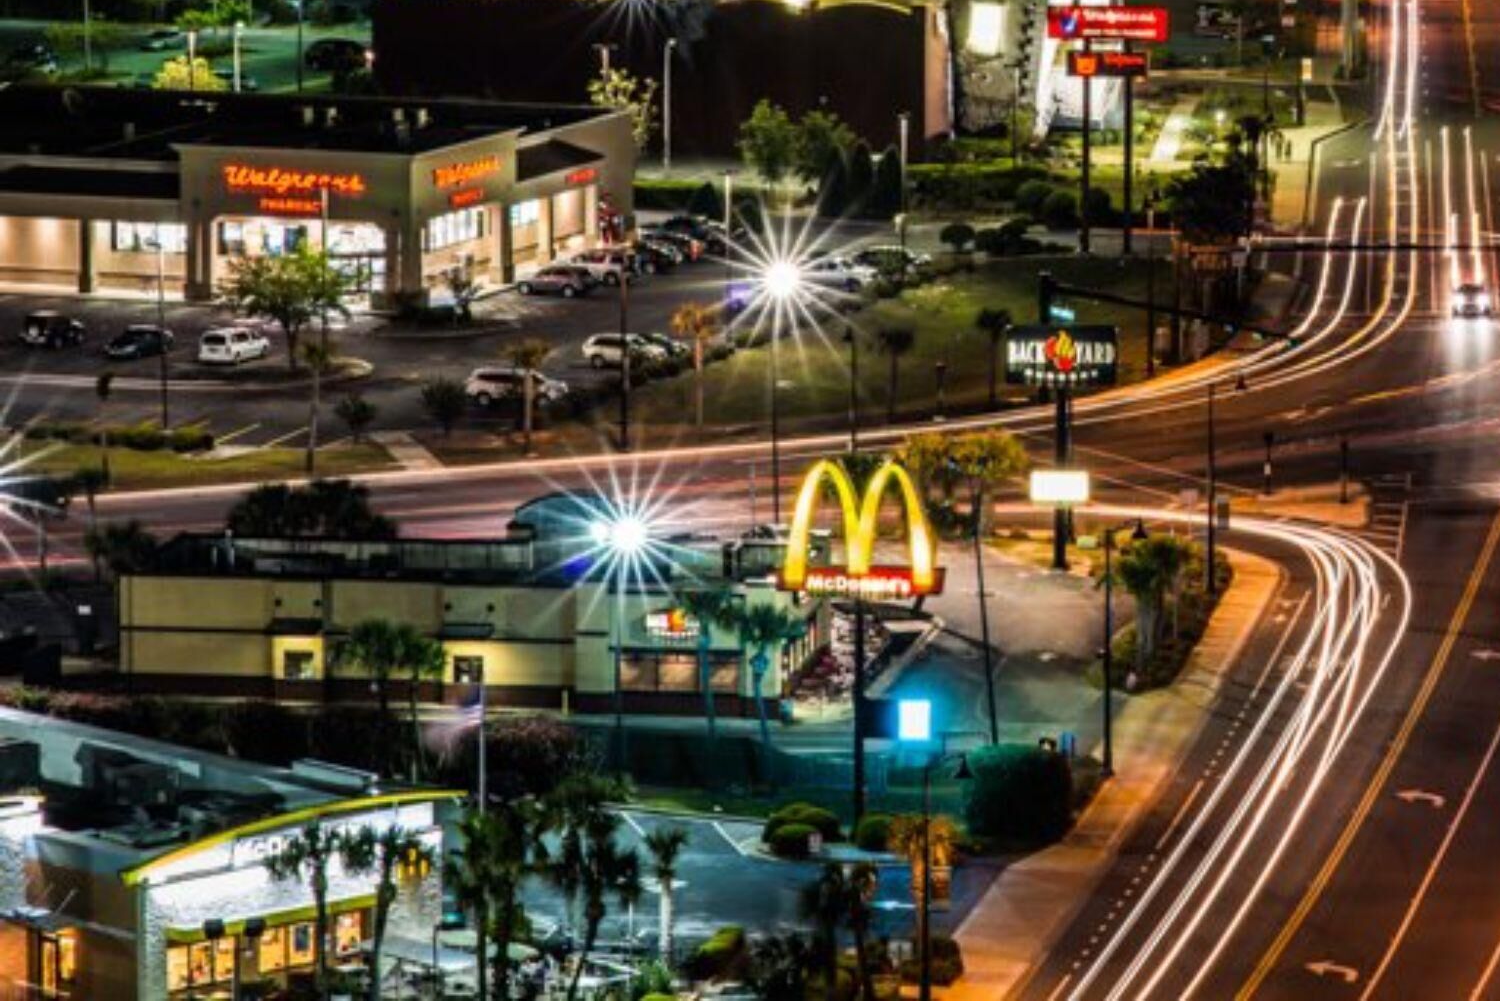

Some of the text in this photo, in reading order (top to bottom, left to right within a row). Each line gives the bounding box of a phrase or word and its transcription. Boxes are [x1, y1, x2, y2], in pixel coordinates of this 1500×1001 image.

[224, 165, 365, 194] Walgreens
[1007, 340, 1116, 365] BACK YARD
[806, 574, 911, 594] McDonald's
